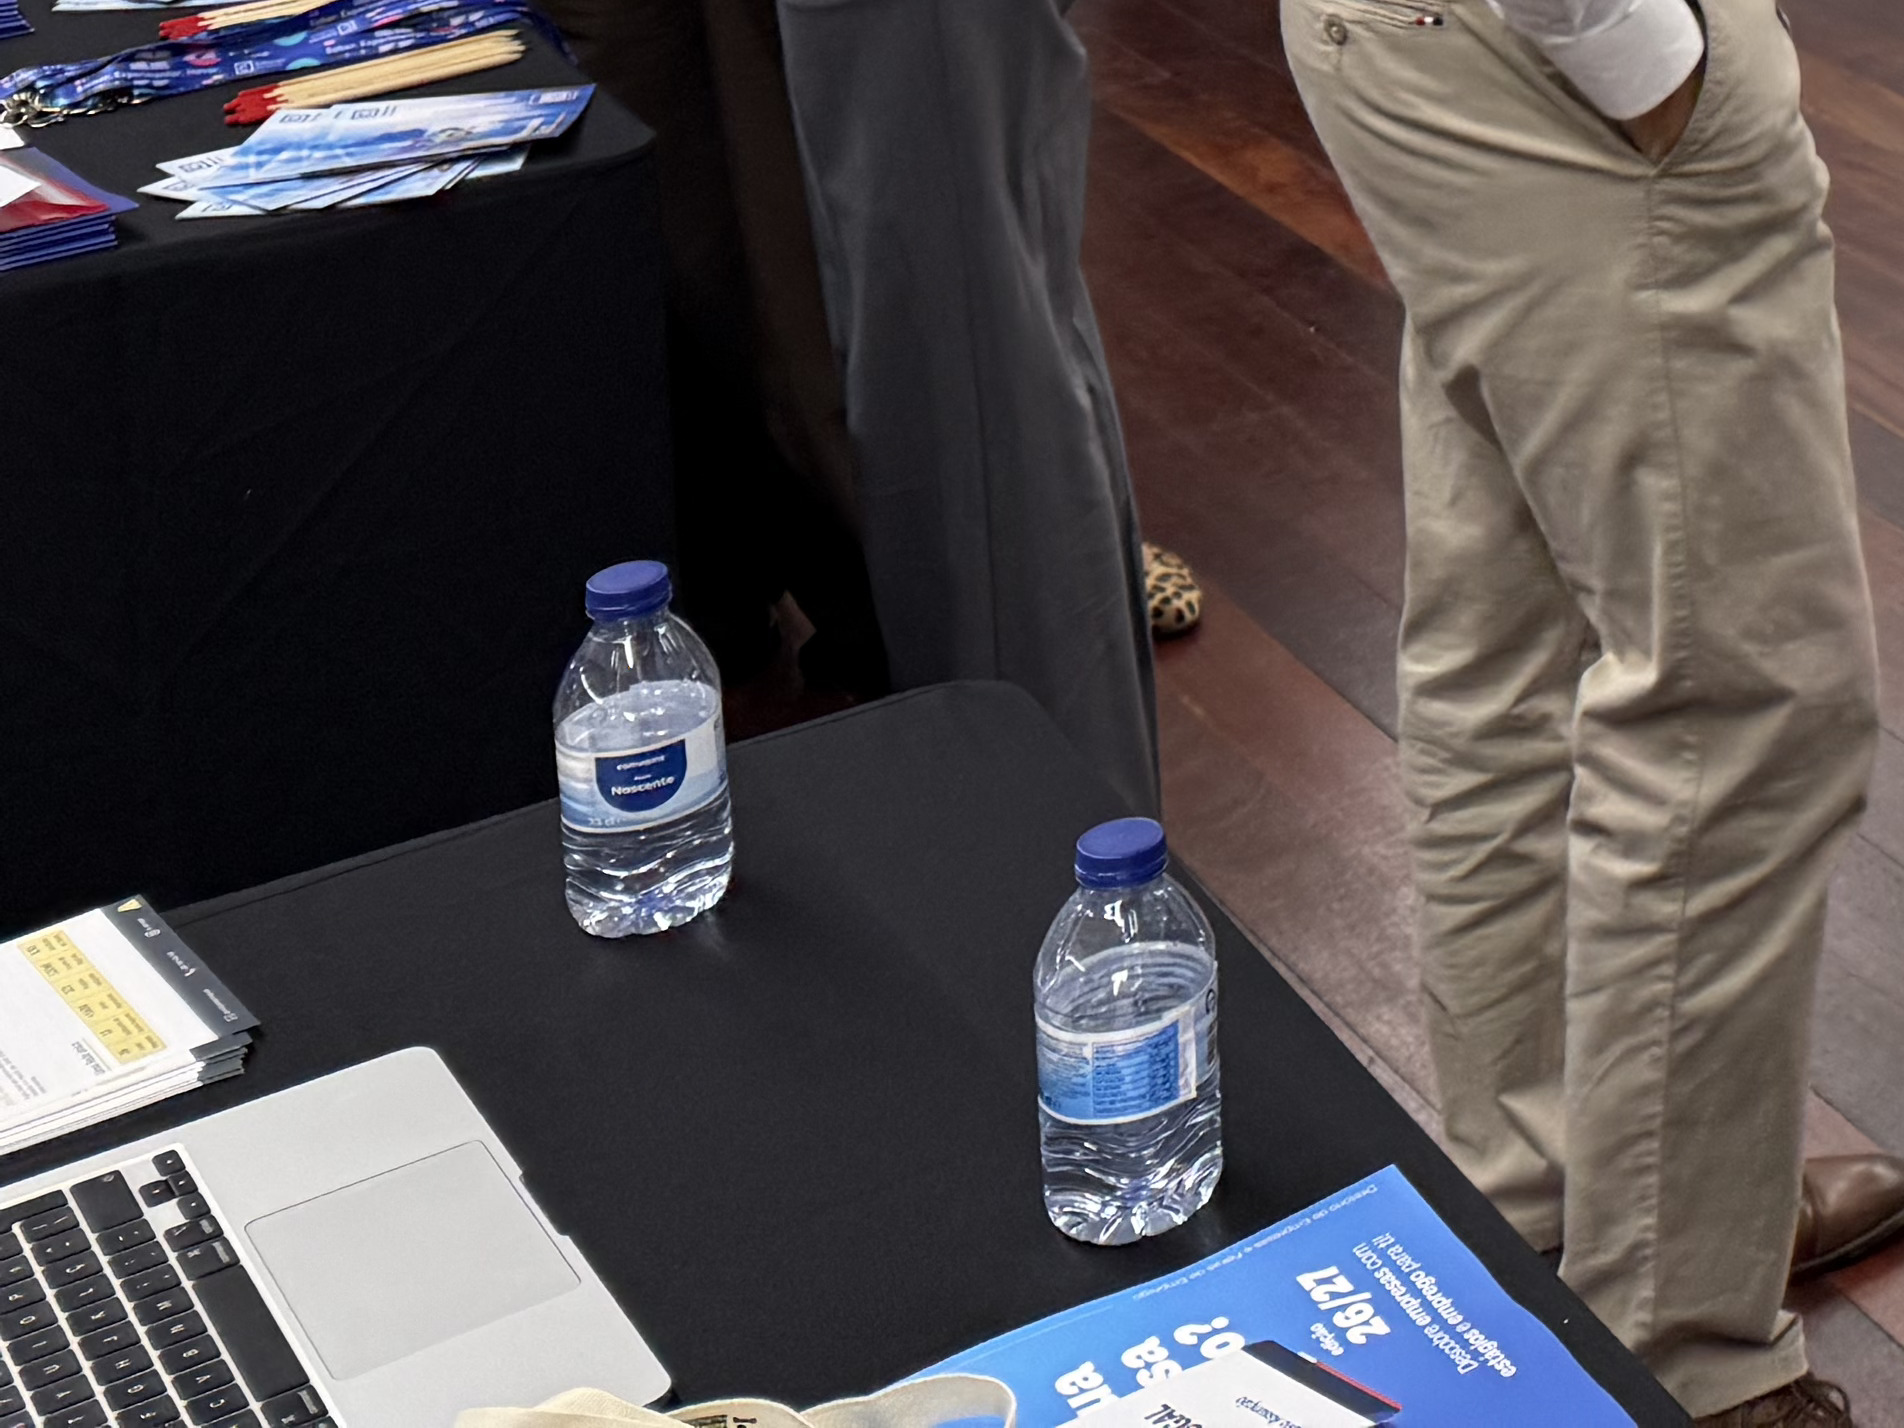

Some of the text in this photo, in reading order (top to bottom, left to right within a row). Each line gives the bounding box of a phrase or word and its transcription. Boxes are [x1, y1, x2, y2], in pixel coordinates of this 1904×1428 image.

[1353, 1242, 1382, 1270] com
[1387, 1246, 1421, 1274] para
[1296, 1265, 1391, 1345] 26/27
[1374, 1267, 1431, 1326] empresas
[1410, 1270, 1464, 1326] emprego
[1463, 1329, 1517, 1378] estágios
